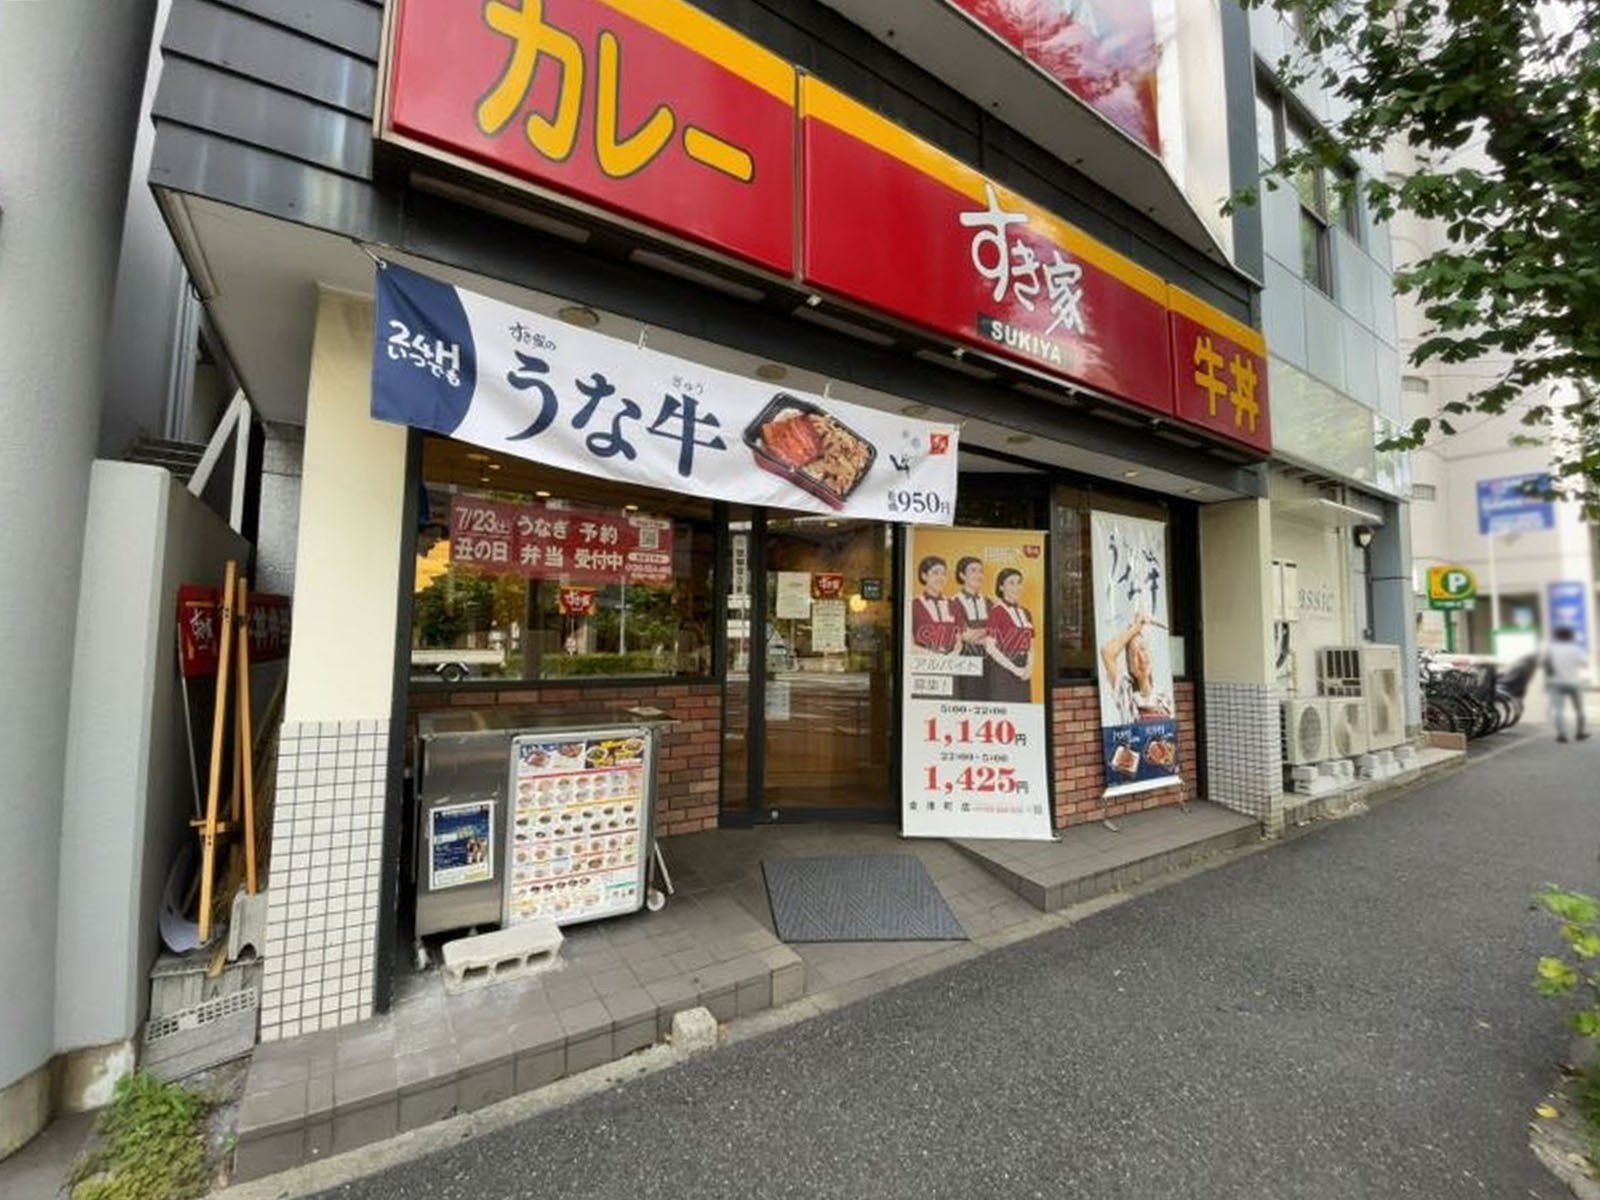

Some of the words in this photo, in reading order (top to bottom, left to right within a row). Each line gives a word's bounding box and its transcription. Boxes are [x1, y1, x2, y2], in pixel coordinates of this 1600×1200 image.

[477, 0, 755, 184] カレー
[960, 181, 1085, 334] すき家
[389, 320, 460, 371] 24H
[991, 320, 1061, 364] SUKIYA
[387, 345, 461, 387] いつでも
[1194, 335, 1259, 433] 牛丼
[505, 350, 728, 478] うな牛
[517, 514, 570, 540] うなぎ
[579, 522, 618, 545] 予約
[455, 537, 508, 562] 丑の日
[520, 544, 564, 568] 弁当
[574, 550, 623, 571] 受付中
[913, 655, 980, 672] アルバイト
[924, 716, 1027, 746] 1,140円
[924, 765, 1030, 795] 1,425円
